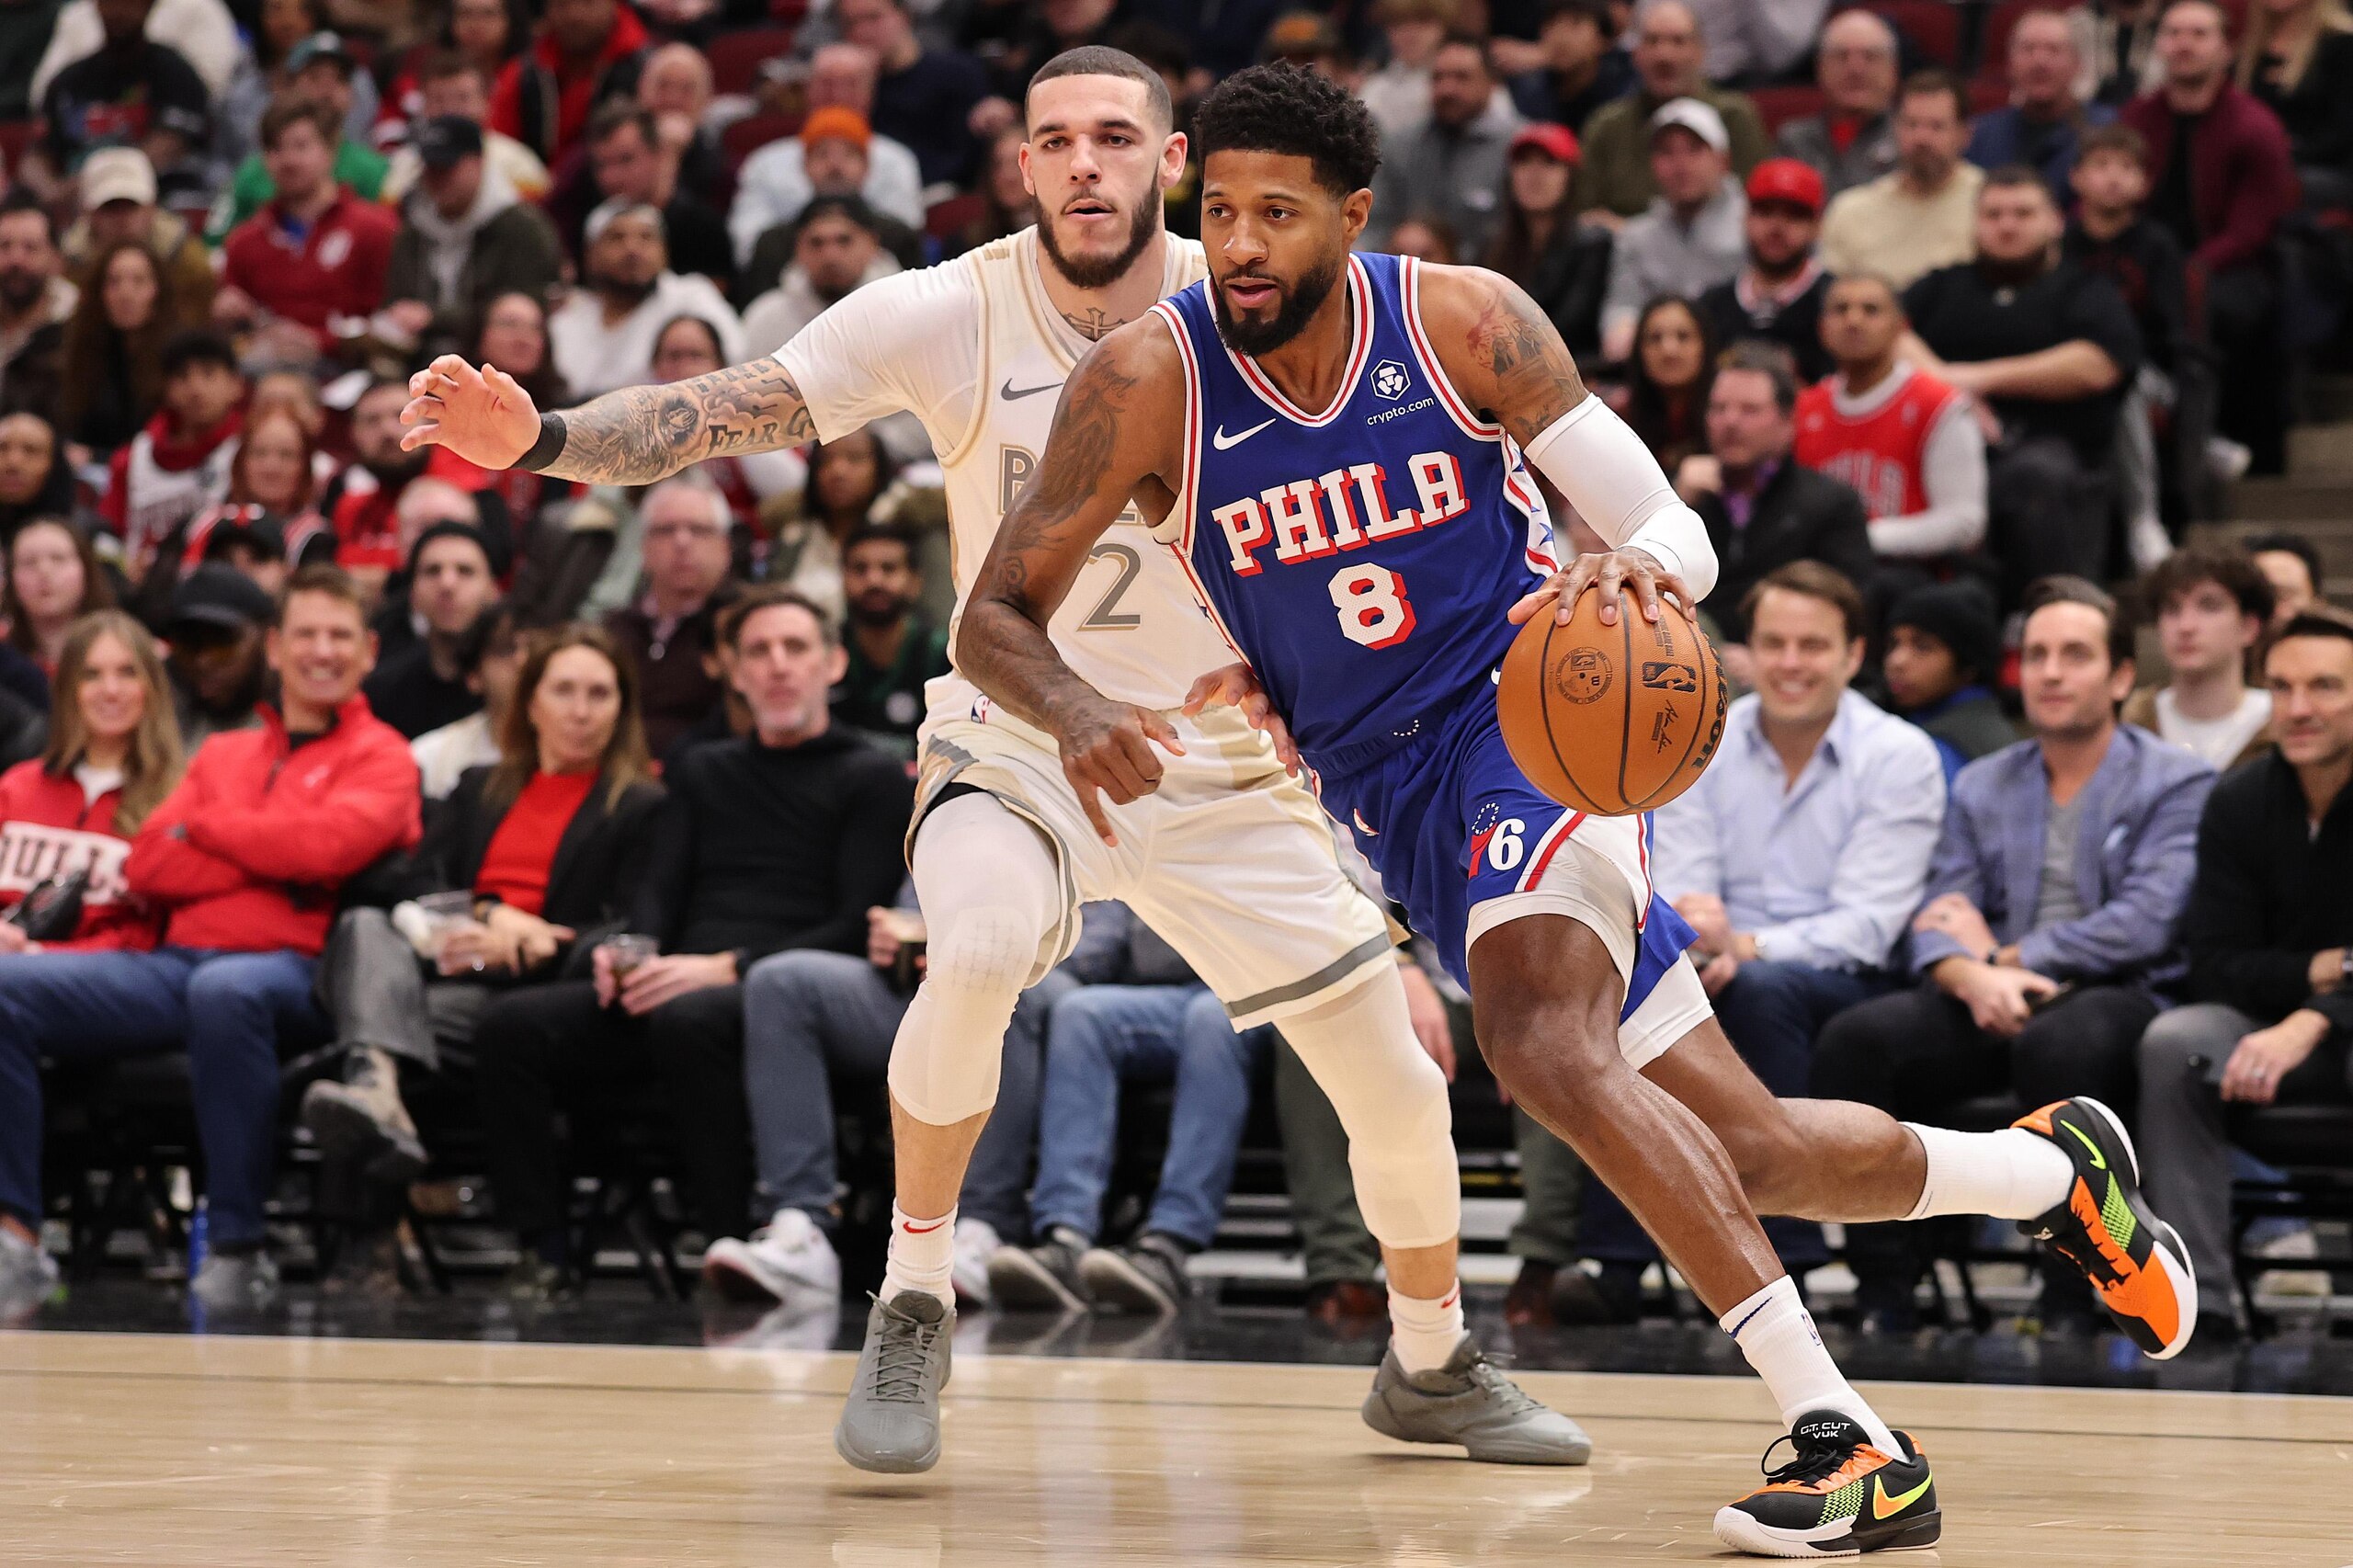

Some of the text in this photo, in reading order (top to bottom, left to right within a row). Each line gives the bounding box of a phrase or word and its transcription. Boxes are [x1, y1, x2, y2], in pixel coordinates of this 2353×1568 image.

[1367, 398, 1434, 425] crypto.com
[706, 422, 778, 457] FEAR
[1211, 450, 1470, 577] PHILA
[1076, 543, 1141, 632] 2
[1327, 562, 1416, 651] 8
[1801, 1422, 1851, 1435] G.T. CUT
[1813, 1430, 1839, 1438] VUK
